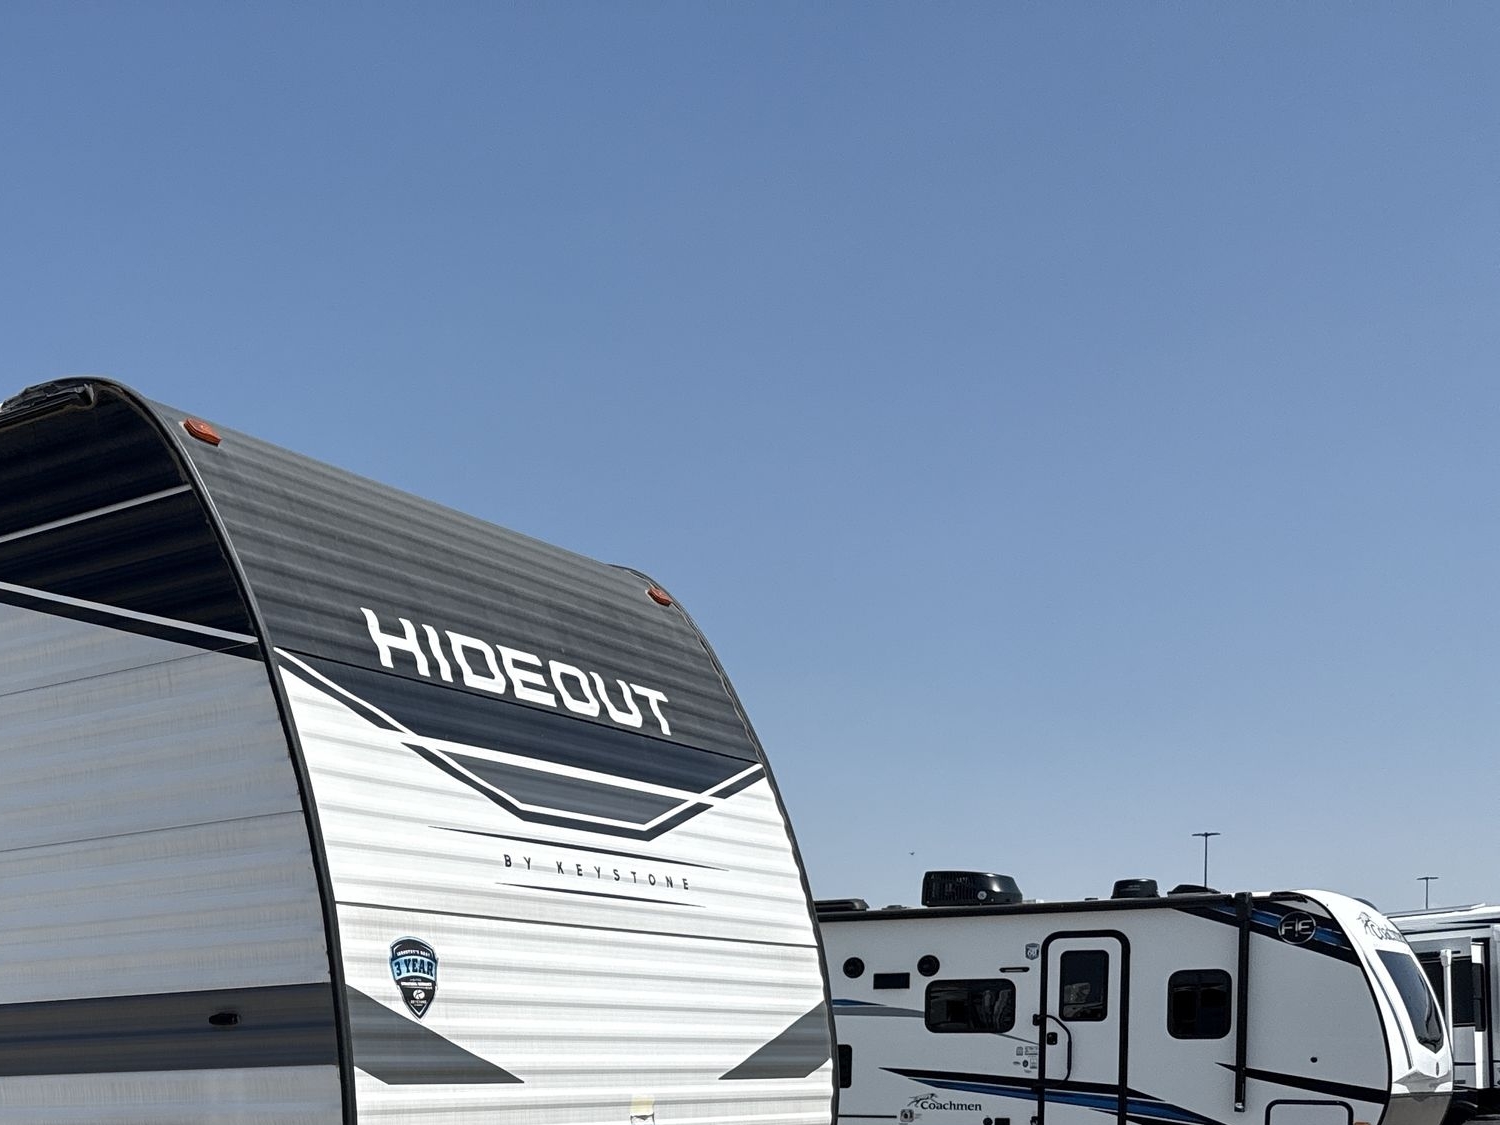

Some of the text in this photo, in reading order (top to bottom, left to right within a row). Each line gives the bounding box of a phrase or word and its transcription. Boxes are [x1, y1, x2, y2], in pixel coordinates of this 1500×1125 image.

[360, 607, 671, 736] HIDEOUT
[503, 854, 689, 890] BY KEYSTONE
[394, 958, 434, 978] 3 YEAR
[920, 1101, 982, 1112] Coachmen
